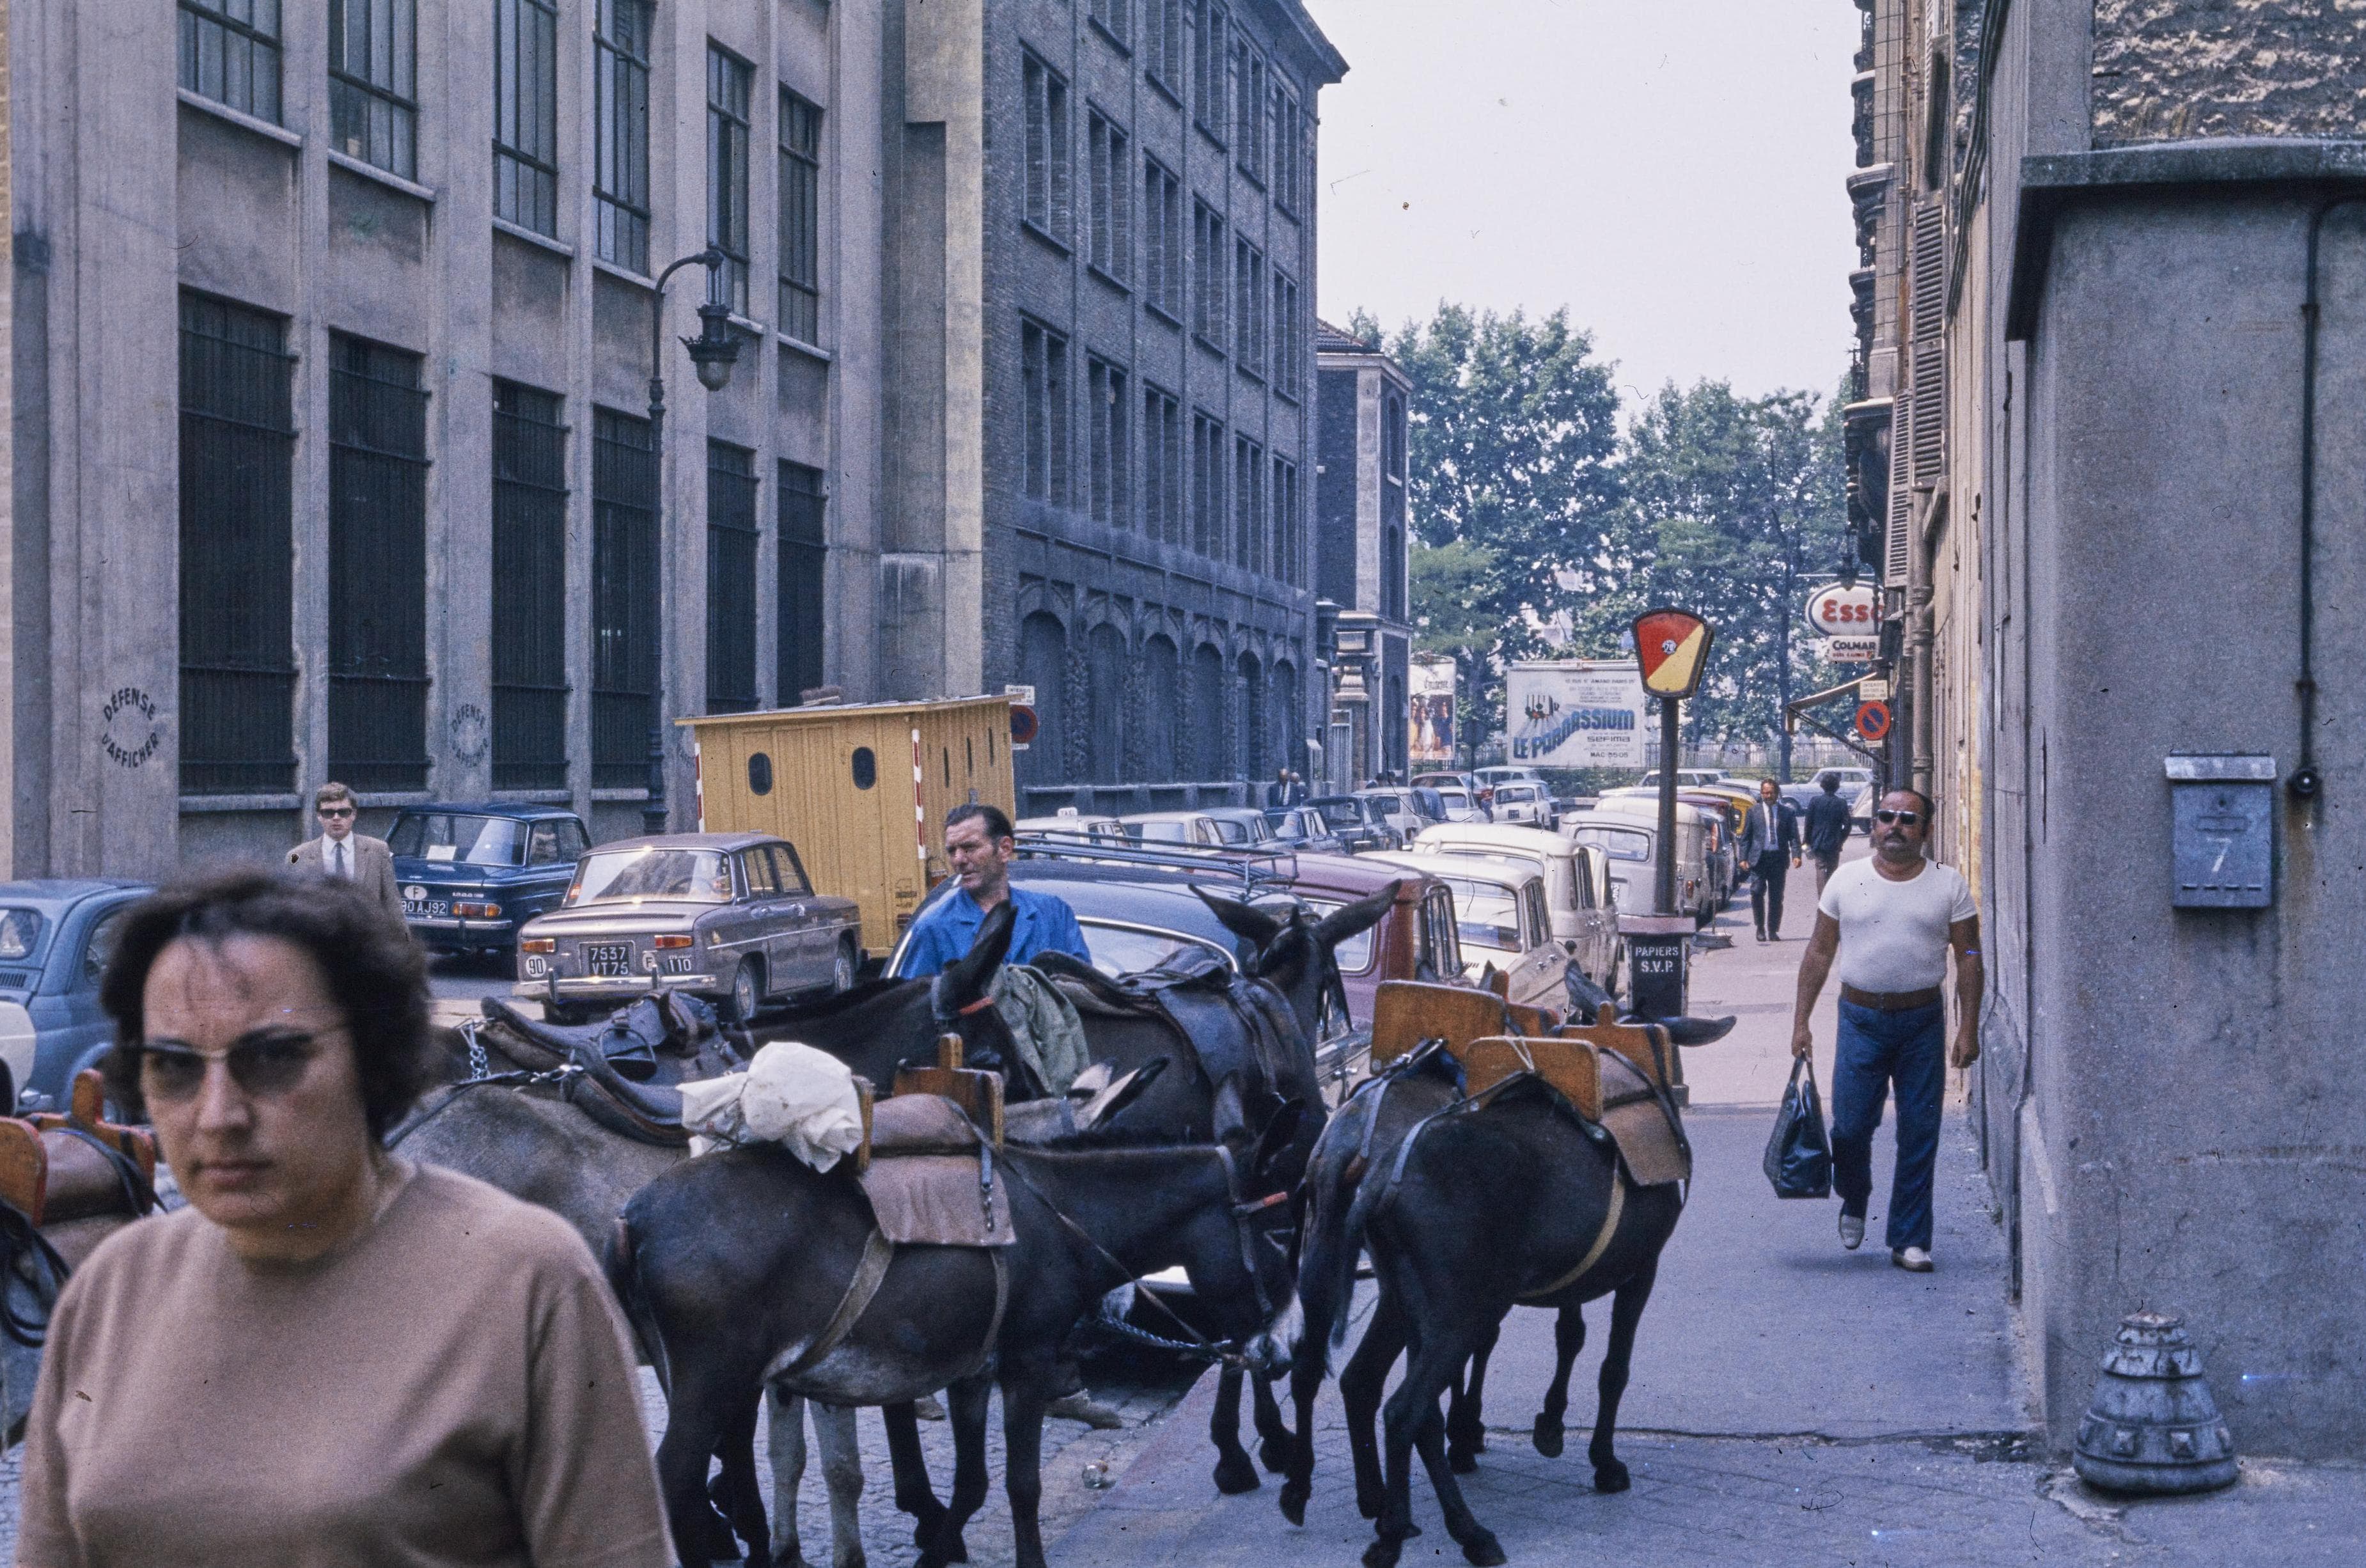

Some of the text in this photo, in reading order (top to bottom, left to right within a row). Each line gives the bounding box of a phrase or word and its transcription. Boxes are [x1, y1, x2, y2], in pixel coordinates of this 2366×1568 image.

[1833, 640, 1876, 651] COLMAR
[1514, 737, 1528, 759] LE
[413, 886, 419, 898] F
[590, 946, 626, 960] 7537
[1635, 946, 1679, 957] PAPIERS
[529, 959, 544, 974] 90
[646, 957, 653, 967] F
[1641, 960, 1673, 973] S.V.P.
